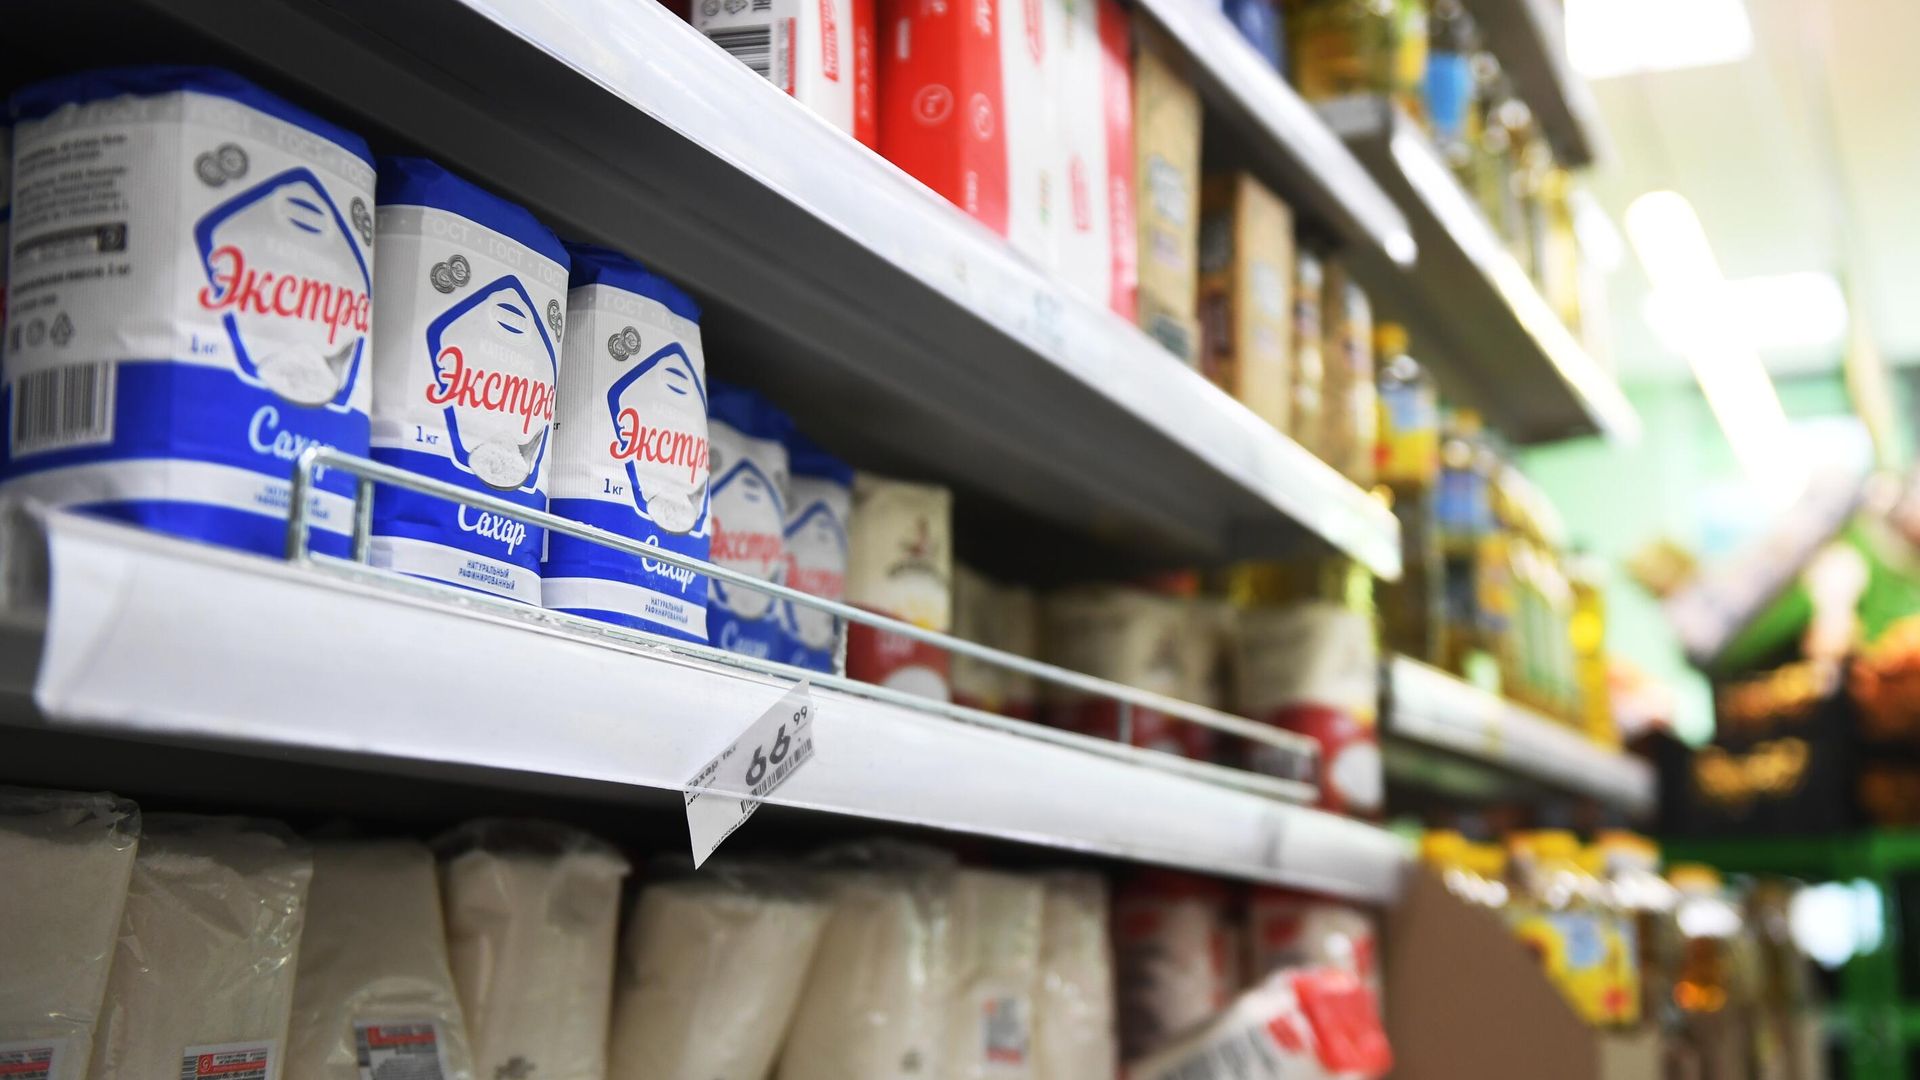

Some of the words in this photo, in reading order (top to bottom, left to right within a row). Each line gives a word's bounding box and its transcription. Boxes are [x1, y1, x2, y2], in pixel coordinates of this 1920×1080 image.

[487, 236, 525, 266] ГОСТ
[201, 246, 371, 344] Экстра
[426, 346, 555, 434] Экстра
[415, 425, 424, 443] 1
[425, 434, 439, 446] кг
[603, 478, 610, 494] 1
[612, 485, 624, 496] кг
[457, 503, 527, 555] Сахар
[458, 567, 516, 591] РАФИНИРОВАННЫЙ
[466, 560, 510, 579] НАТУРАЛЬНЫЙ
[745, 723, 791, 786] 66
[793, 705, 808, 726] 99
